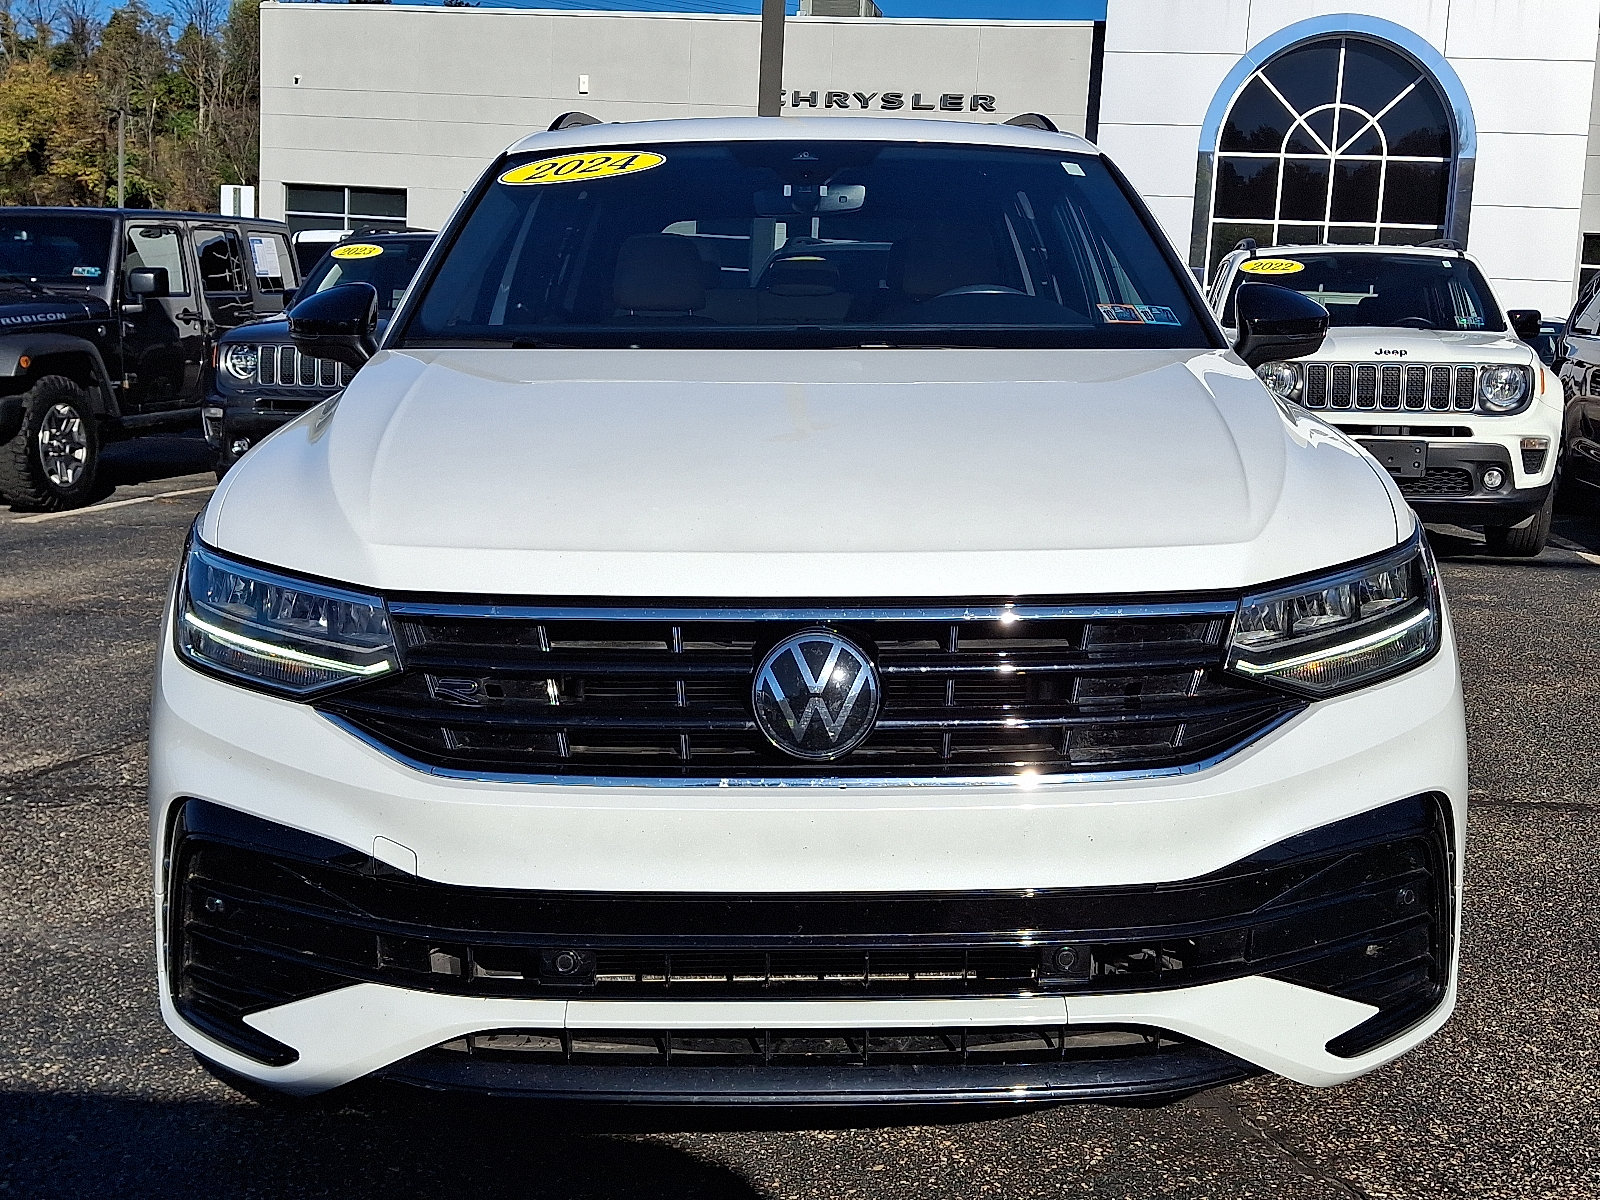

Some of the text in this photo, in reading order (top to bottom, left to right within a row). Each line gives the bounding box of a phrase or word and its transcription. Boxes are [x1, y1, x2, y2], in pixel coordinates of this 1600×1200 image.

[781, 89, 997, 112] HRYSLER
[523, 154, 641, 181] 2024
[338, 247, 377, 256] 2023
[1249, 261, 1295, 271] 2022
[0, 312, 67, 325] RUBICON
[1374, 348, 1408, 358] Jeep
